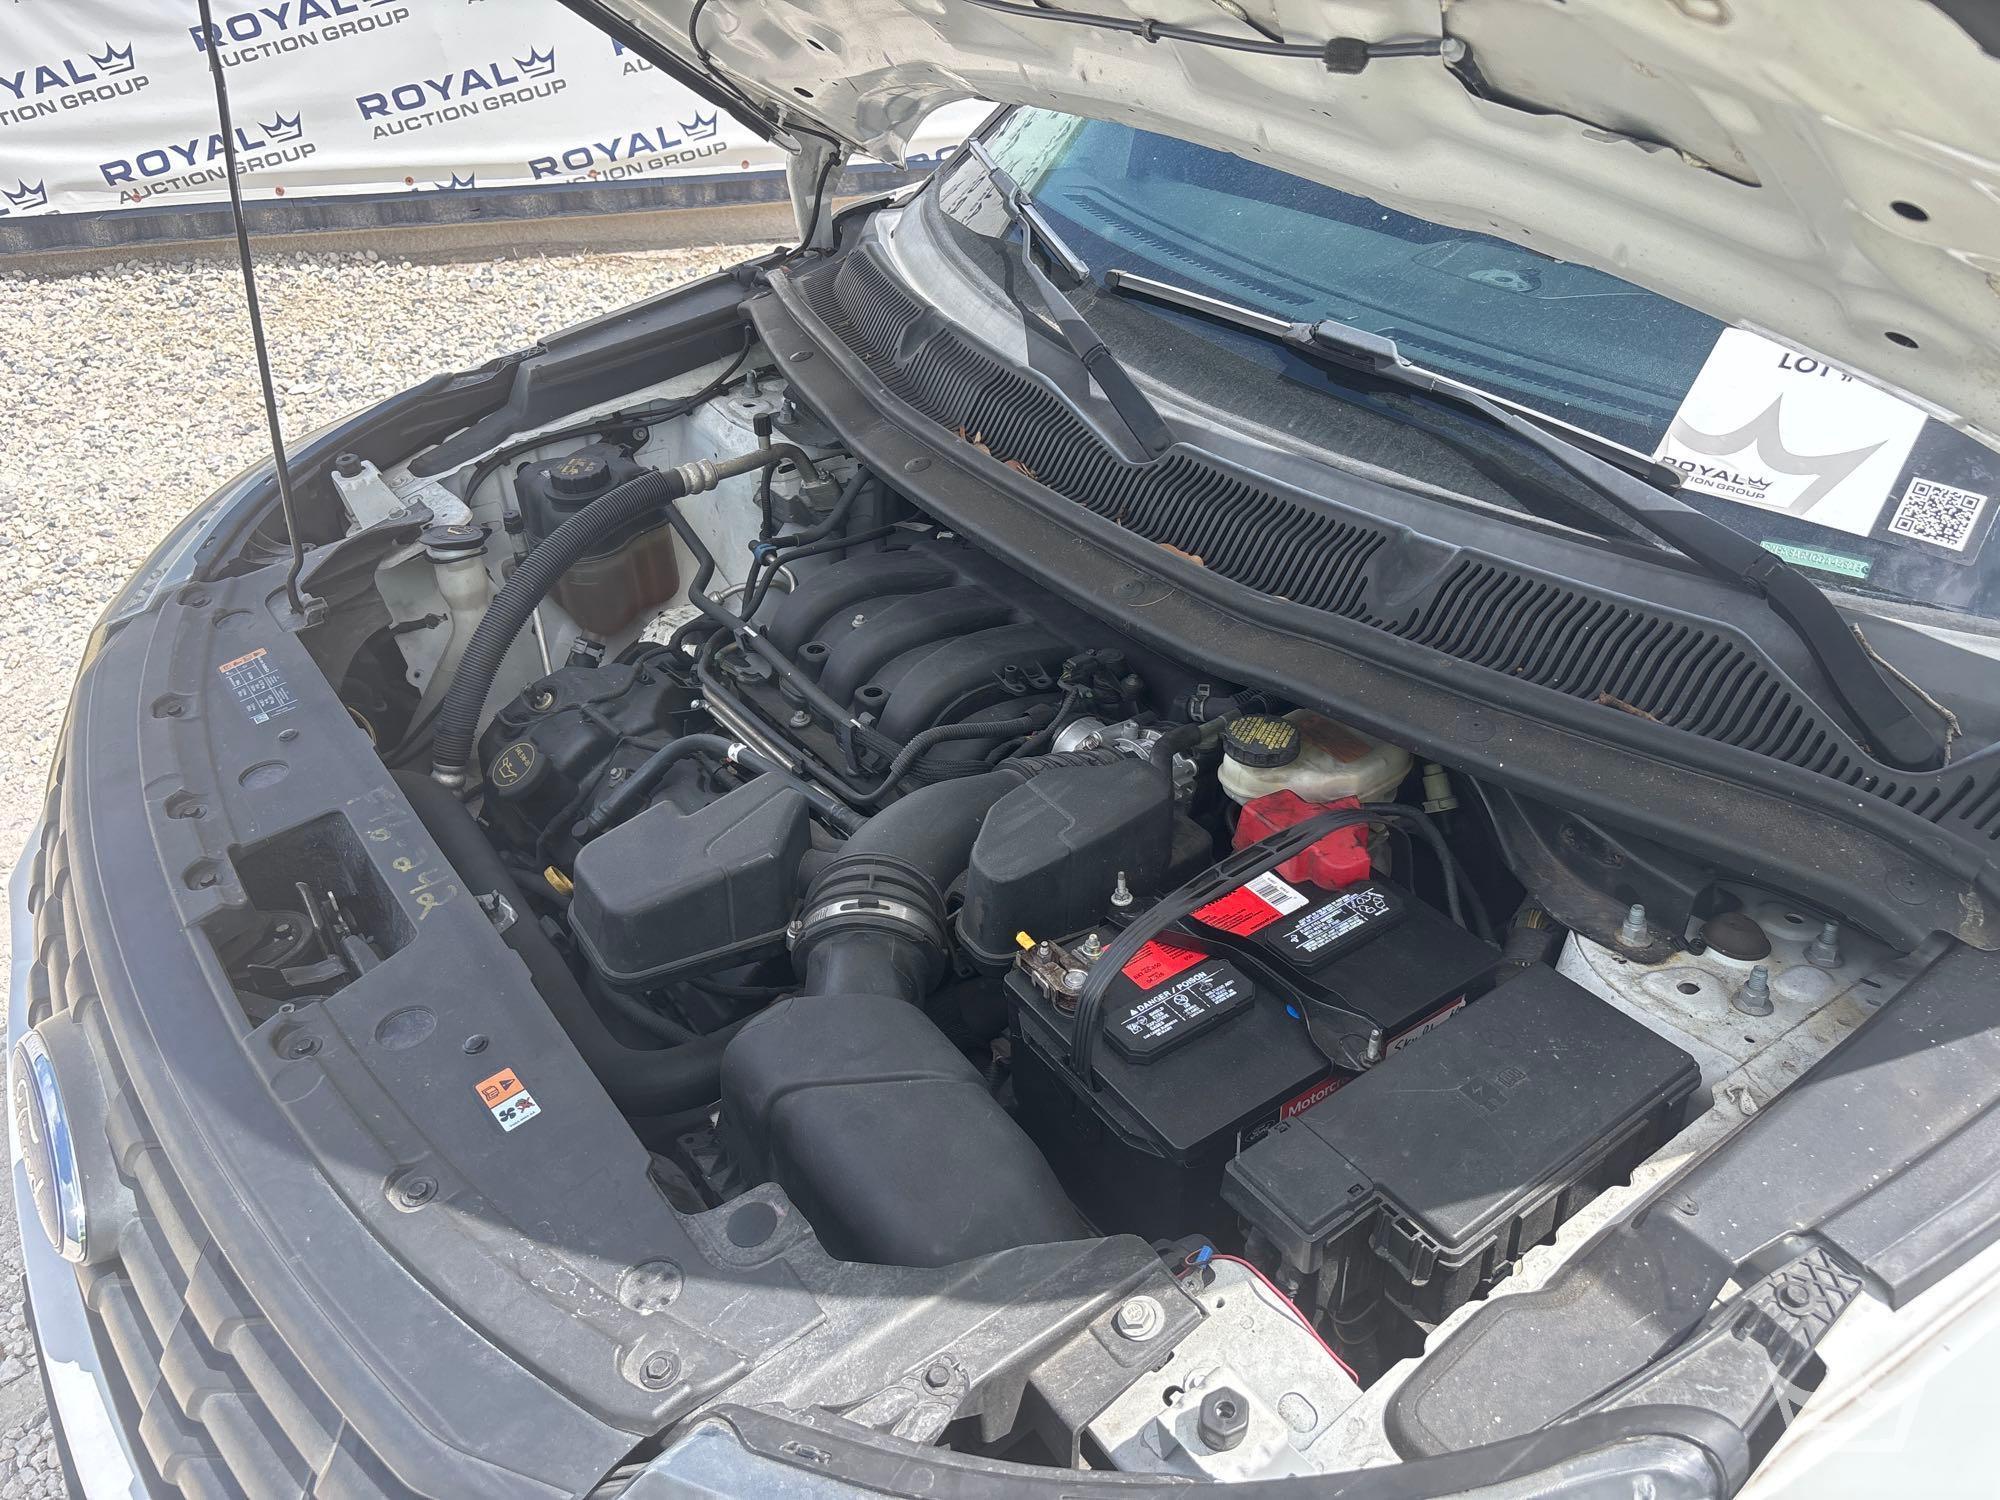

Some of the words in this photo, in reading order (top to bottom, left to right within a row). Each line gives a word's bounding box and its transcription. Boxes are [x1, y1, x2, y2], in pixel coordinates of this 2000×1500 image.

[189, 0, 359, 52] ROYAL
[321, 8, 409, 41] GROUP
[0, 59, 98, 99] YAL
[0, 100, 58, 126] TION
[60, 75, 150, 109] GROUP
[355, 63, 519, 120] ROYAL
[373, 101, 479, 139] AUCTION
[483, 79, 567, 110] GROUP
[99, 128, 266, 186] ROYAL
[120, 166, 226, 204] AUCTION
[234, 143, 316, 176] GROUP
[528, 127, 682, 180] ROYAL
[648, 142, 728, 170] GROUP
[1716, 482, 1766, 499] GROUP
[1136, 989, 1172, 1012] DANGER
[1177, 971, 1208, 991] POISON
[1287, 1078, 1345, 1118] Motorcr
